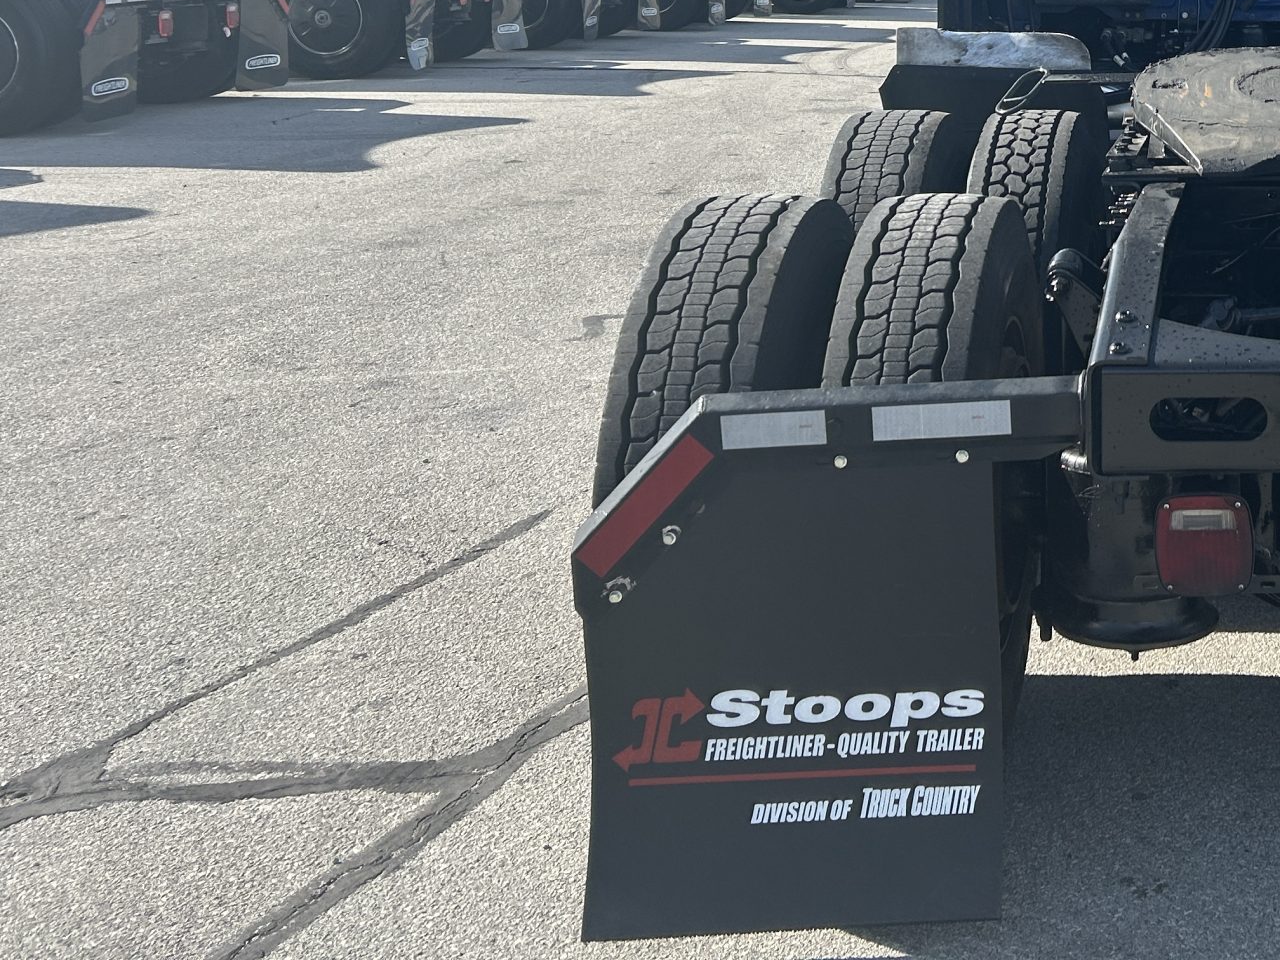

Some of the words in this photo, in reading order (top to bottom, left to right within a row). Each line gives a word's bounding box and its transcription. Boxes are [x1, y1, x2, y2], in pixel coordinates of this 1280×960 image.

[707, 689, 984, 727] Stoops
[917, 728, 984, 754] TRAILER
[751, 800, 829, 824] DIVISION
[830, 800, 853, 820] OF
[860, 788, 909, 818] TRUCK
[910, 785, 981, 816] COUNTRY
